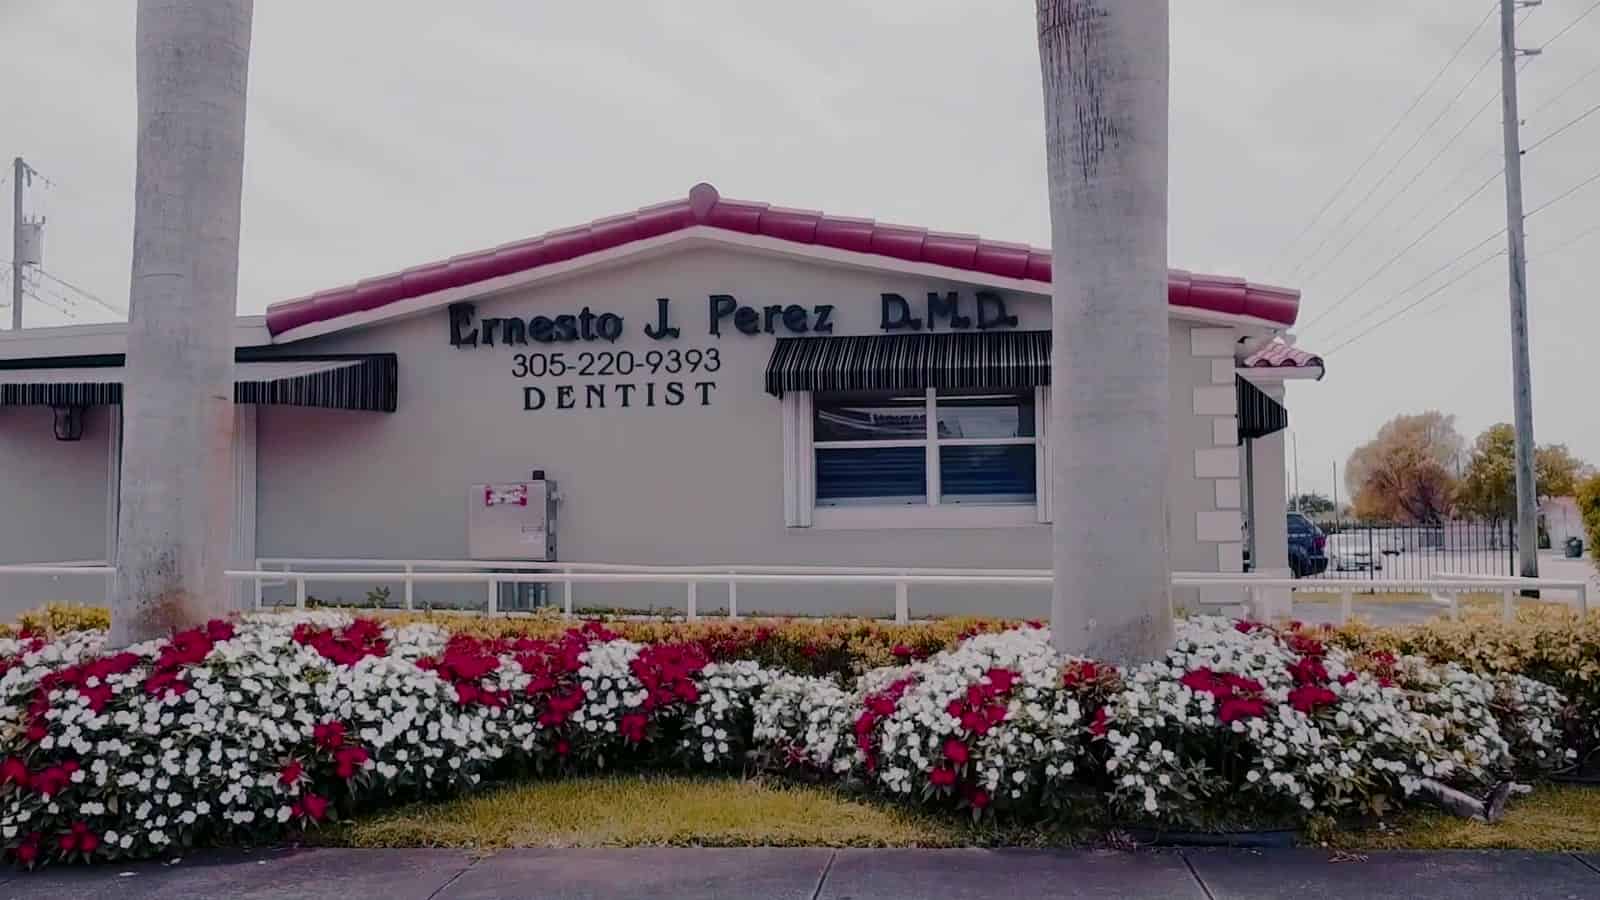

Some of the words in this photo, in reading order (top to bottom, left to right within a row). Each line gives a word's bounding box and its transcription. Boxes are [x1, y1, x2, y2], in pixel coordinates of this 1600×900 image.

[448, 301, 624, 347] Ernesto
[709, 294, 834, 337] Perez
[880, 291, 1018, 332] D.M.D.
[512, 348, 720, 377] 305-220-9393
[523, 382, 716, 410] DENTIST
